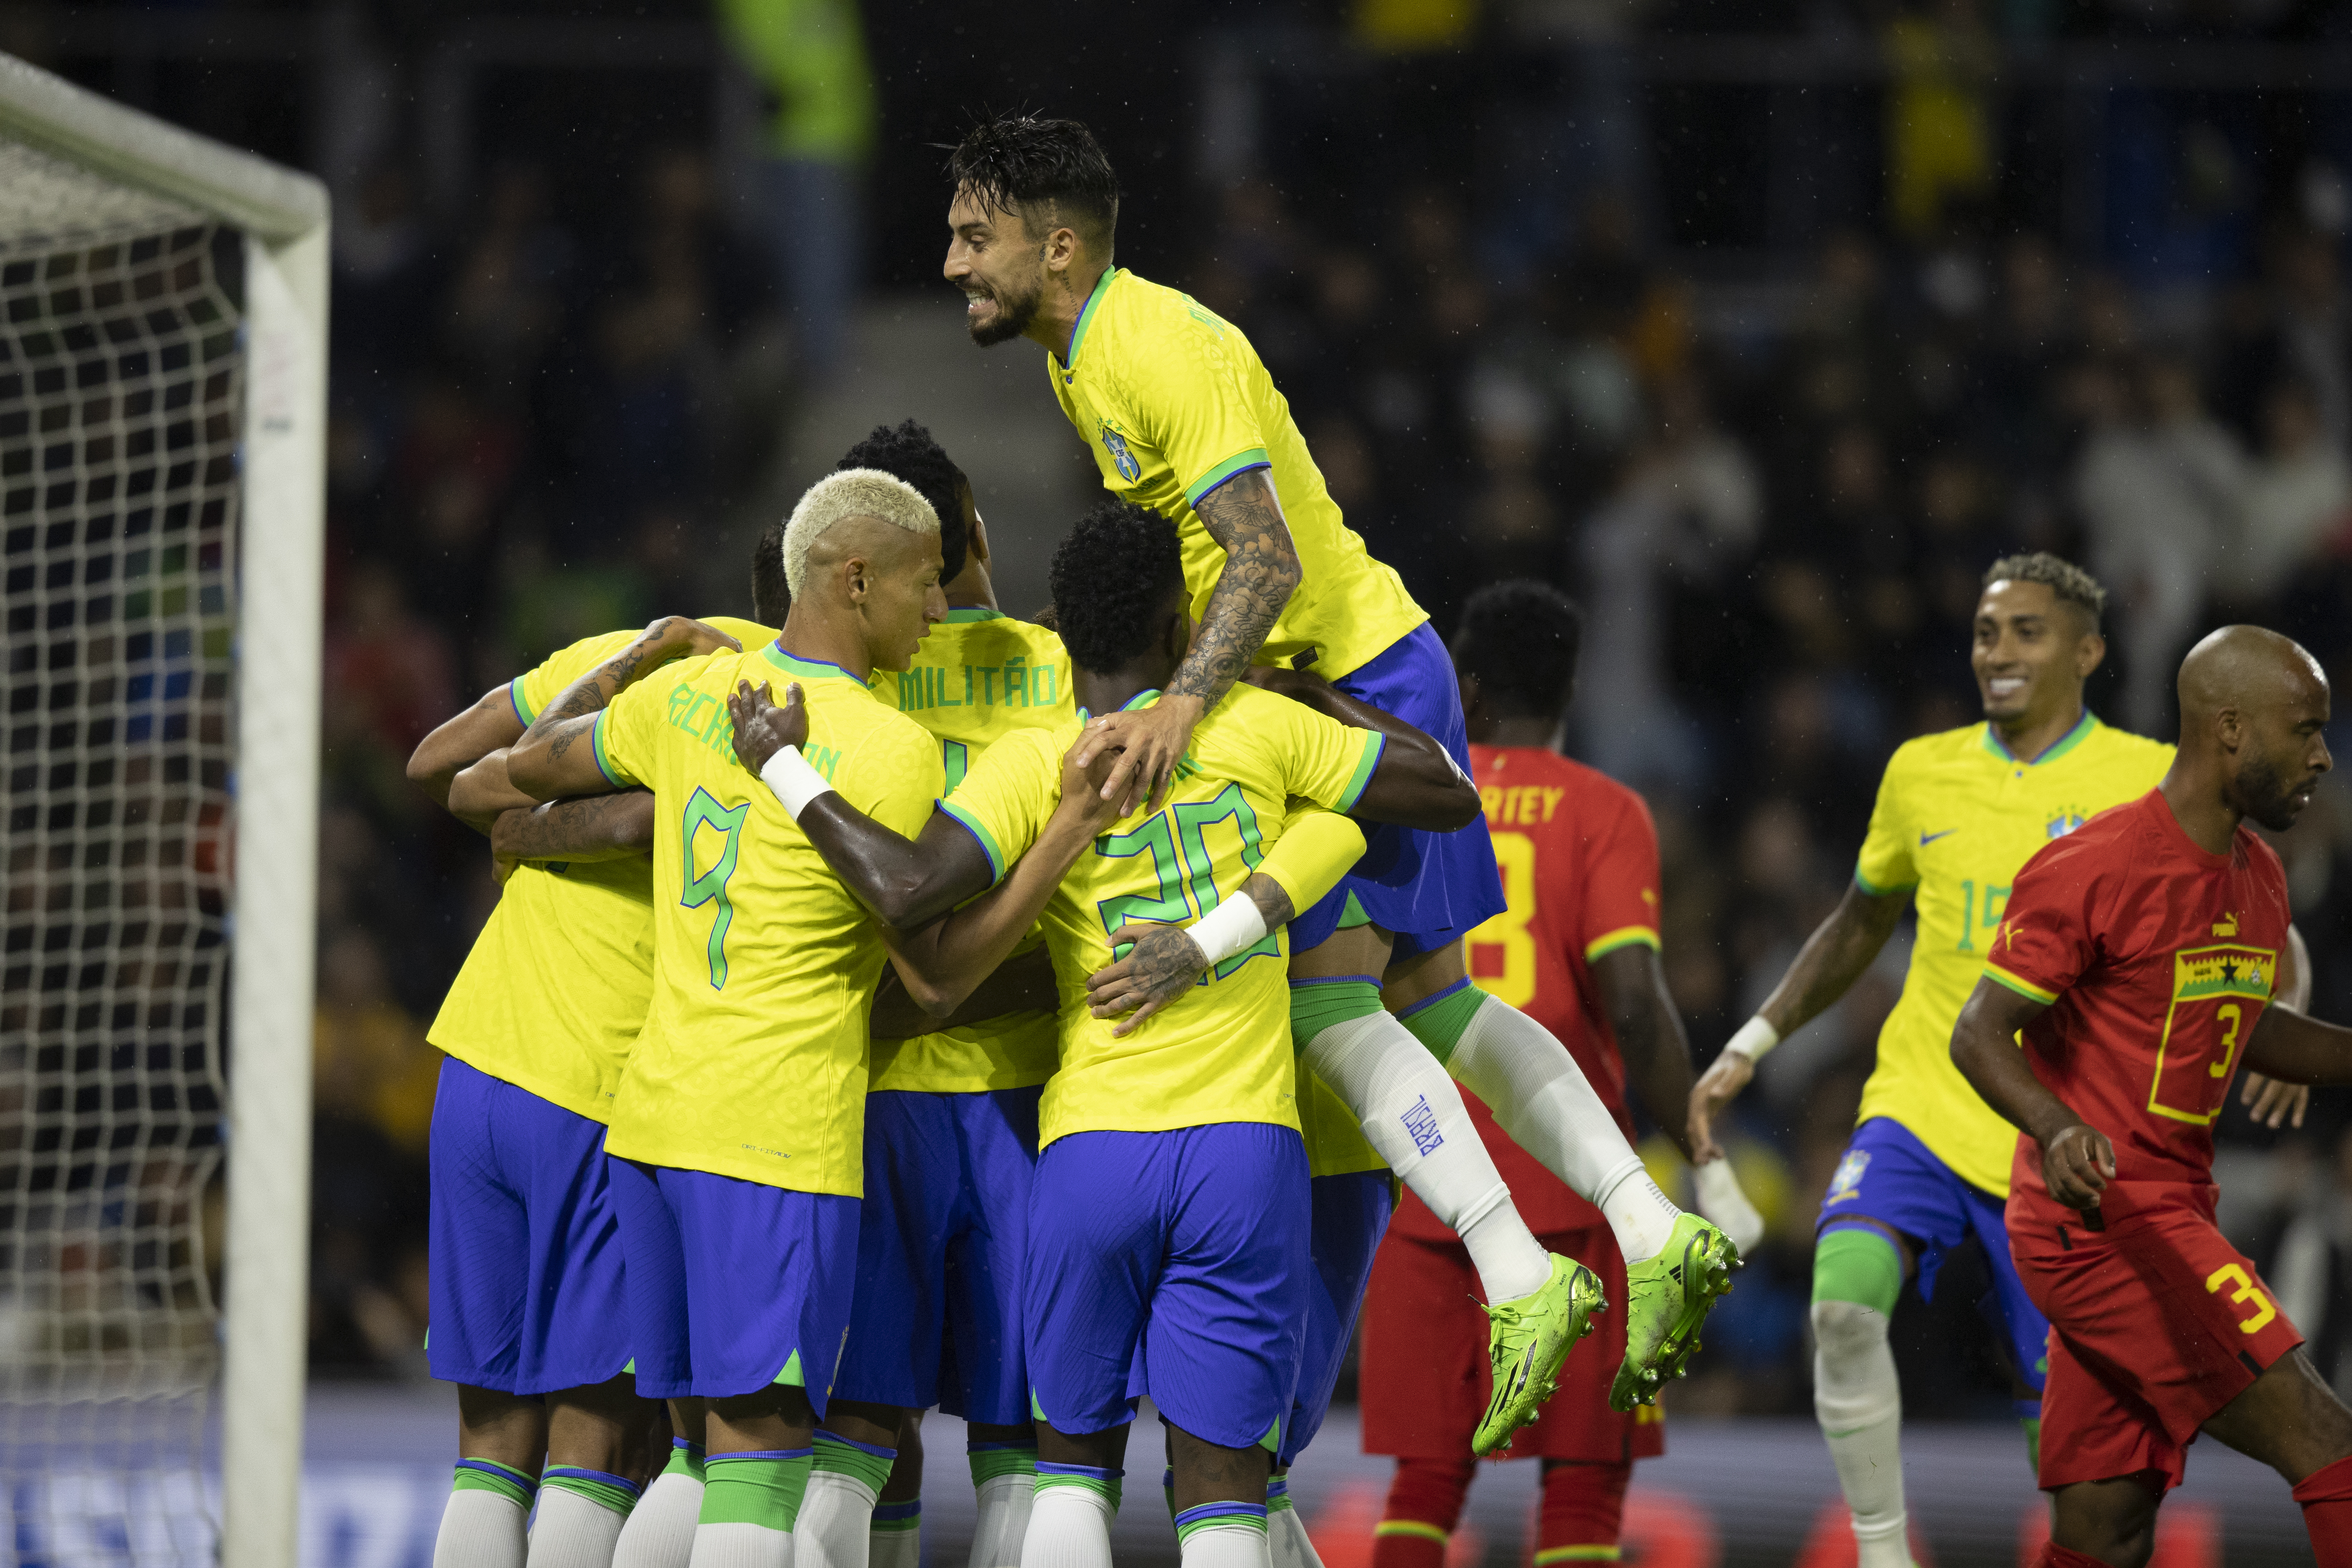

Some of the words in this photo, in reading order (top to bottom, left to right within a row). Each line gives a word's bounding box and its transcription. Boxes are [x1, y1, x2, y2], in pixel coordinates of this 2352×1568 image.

[1115, 449, 1125, 457] CBF
[898, 656, 1057, 712] MILITÃO
[1480, 785, 1565, 826] RTEY
[680, 784, 752, 991] 9
[1095, 780, 1281, 986] 20
[2209, 1003, 2242, 1079] 3
[1400, 1093, 1444, 1157] BRASIL
[2206, 1263, 2276, 1334] 3
